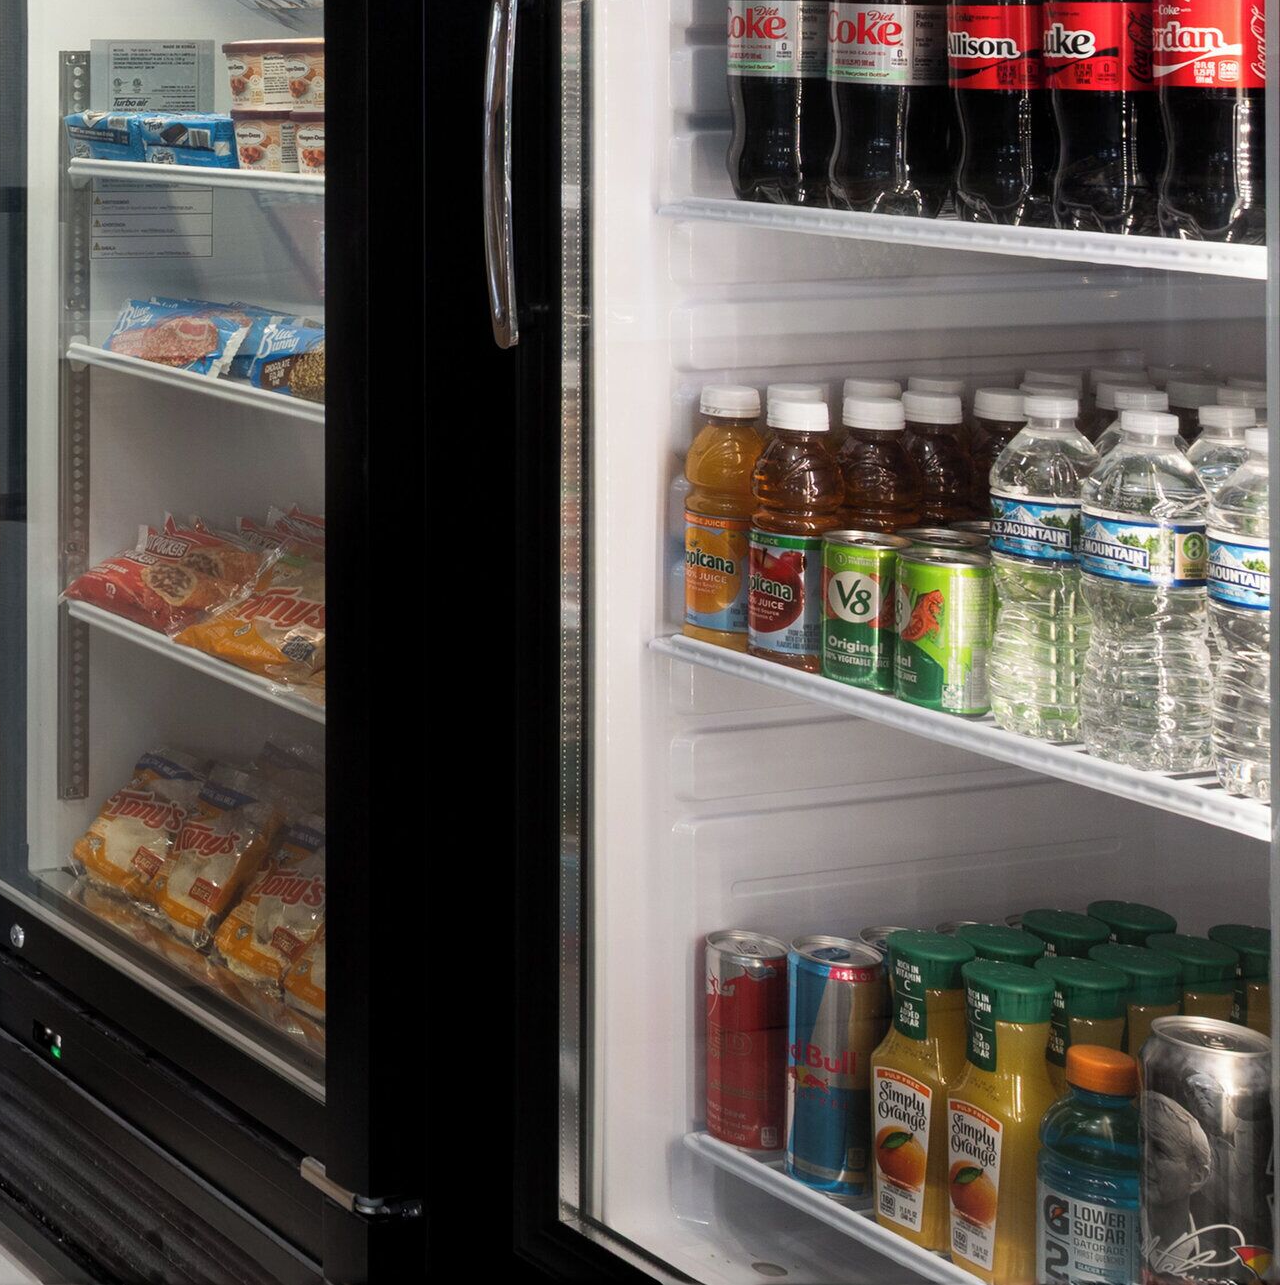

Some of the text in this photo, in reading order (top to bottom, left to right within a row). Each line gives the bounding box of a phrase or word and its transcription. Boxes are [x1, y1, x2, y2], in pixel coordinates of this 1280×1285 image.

[754, 6, 779, 16] Diet
[867, 10, 895, 22] Diet
[1158, 5, 1180, 15] Coke
[1044, 25, 1092, 55] uke
[1153, 23, 1224, 49] ordan
[113, 97, 136, 107] Turbo
[264, 360, 290, 375] CHOCOLATE
[704, 519, 727, 528] JUICE
[1004, 522, 1069, 548] MOUNTAIN
[1084, 540, 1149, 568] MOUNTAIN
[699, 572, 727, 584] JUICE
[758, 599, 785, 610] JUICE
[835, 579, 872, 616] V8
[828, 635, 883, 654] Original
[838, 656, 871, 667] VEGETABLE
[107, 789, 187, 832] Tony's
[896, 966, 921, 983] VITAMIN
[897, 959, 919, 974] RICH IN
[904, 980, 911, 991] C
[981, 993, 989, 1003] IN
[974, 1009, 981, 1020] C
[806, 1044, 857, 1075] Bull
[884, 1071, 921, 1090] PULP FREE
[879, 1080, 925, 1117] Simply
[878, 1101, 926, 1132] Orange
[956, 1103, 991, 1124] PULP FREE
[951, 1112, 996, 1152] Simply
[951, 1134, 996, 1166] Orange
[1073, 1203, 1126, 1229] LOWER
[1073, 1220, 1126, 1245] SUGAR
[1073, 1237, 1126, 1257] GATORADE
